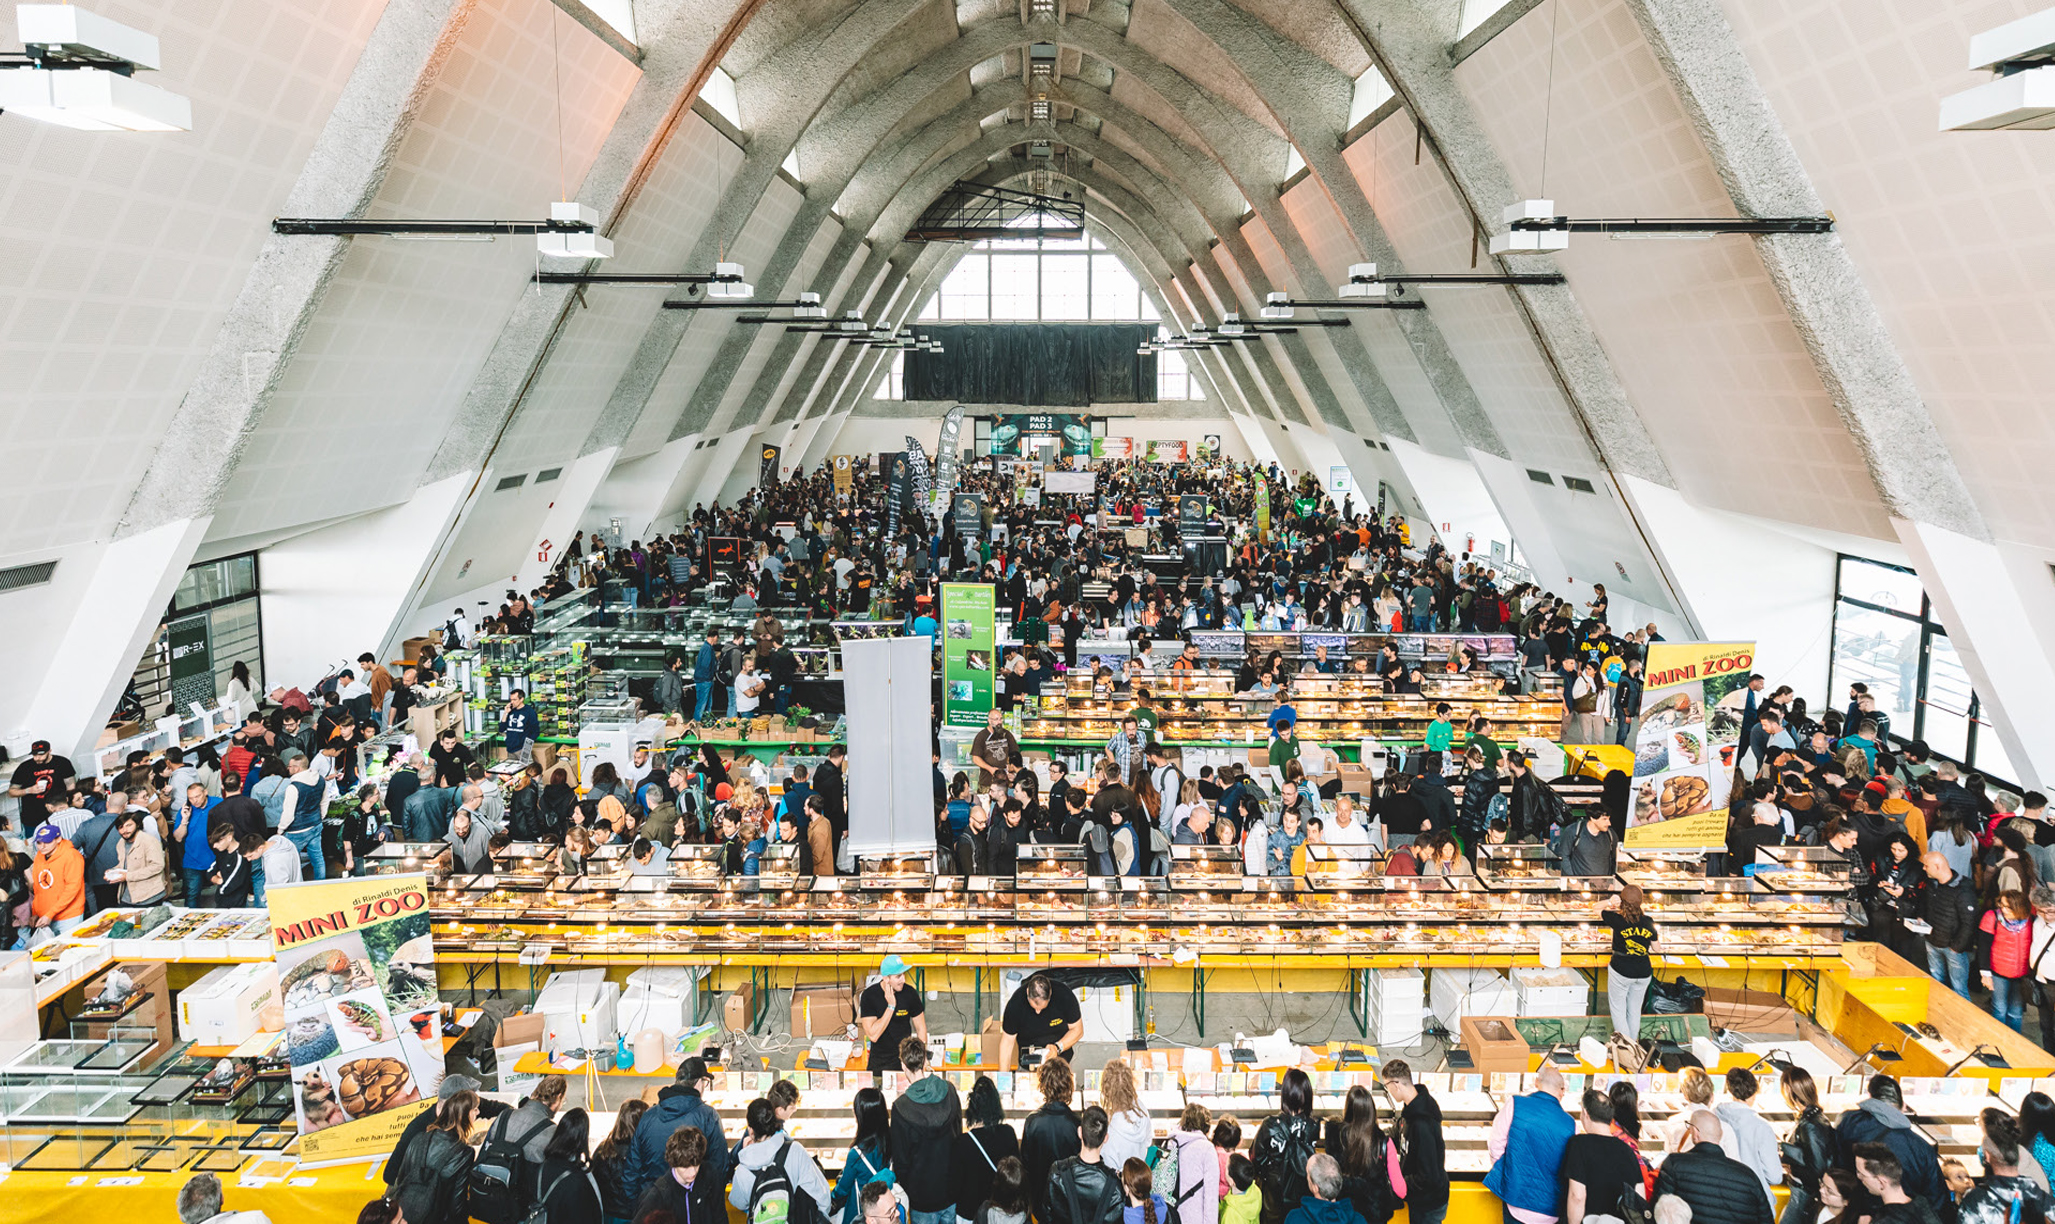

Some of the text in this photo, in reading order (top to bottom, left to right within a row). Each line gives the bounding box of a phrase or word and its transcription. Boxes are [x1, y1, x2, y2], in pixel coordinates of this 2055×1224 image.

[1151, 441, 1184, 449] PTYFOOD
[183, 640, 205, 654] R-EX
[1709, 651, 1732, 660] Rinaldi
[1732, 649, 1750, 657] Denis
[1648, 654, 1752, 688] MINI ZOO
[353, 883, 418, 906] di Rinaldi Denis
[275, 891, 425, 947] MINI ZOO
[1620, 926, 1653, 939] STAFF
[396, 1112, 414, 1122] puoi
[389, 1122, 406, 1131] tutti
[371, 1133, 383, 1141] hai
[384, 1131, 401, 1140] sem
